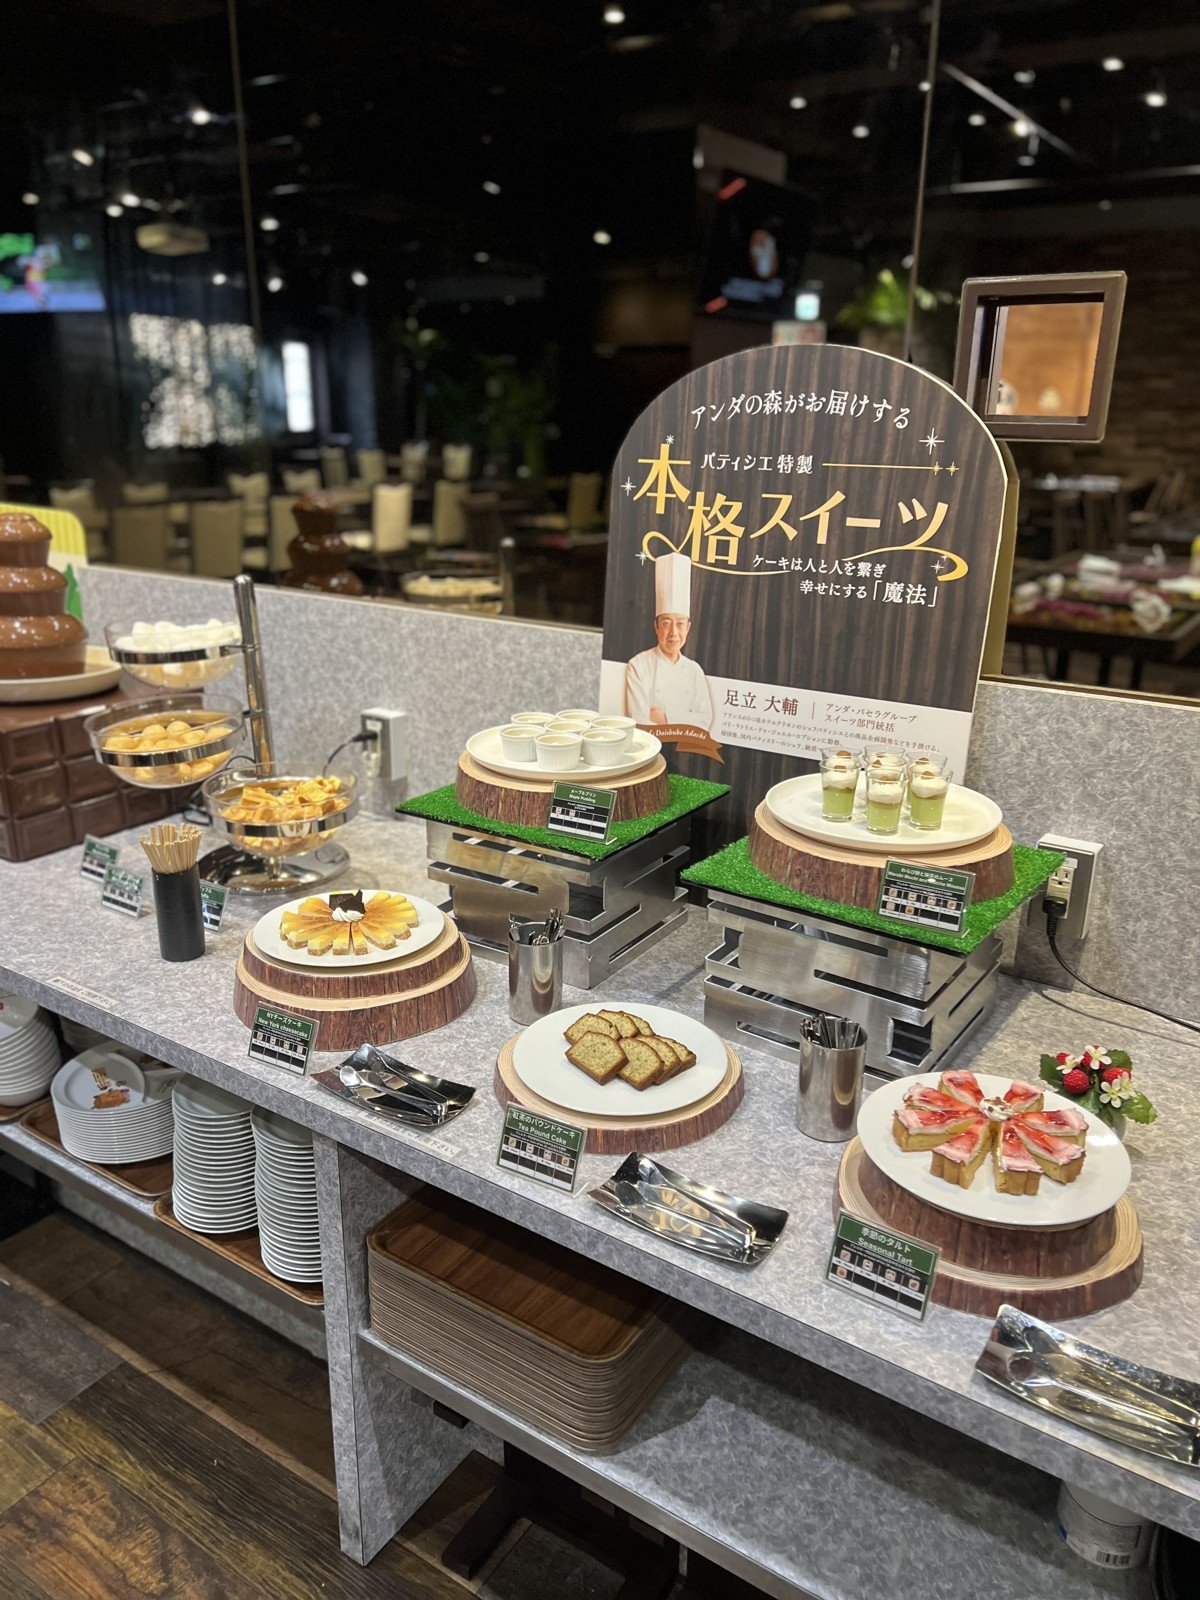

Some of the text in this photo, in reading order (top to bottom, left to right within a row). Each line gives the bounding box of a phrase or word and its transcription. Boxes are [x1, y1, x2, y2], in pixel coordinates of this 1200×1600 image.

[691, 389, 912, 430] アンダの森がお届けする
[700, 452, 814, 475] パティシエ 特製
[632, 443, 949, 566] 本格スイーツ
[752, 554, 887, 578] ケーキは人と人を繋ぎ
[799, 579, 938, 608] 幸せにする「魔法」
[723, 689, 798, 716] 足立 大輔
[684, 729, 707, 740] Adachi
[824, 714, 896, 733] スイーツ部門統括
[258, 1017, 269, 1025] New
[269, 1020, 280, 1029] York
[280, 1024, 308, 1038] cheesecake
[512, 1112, 576, 1139] 紅茶のパウンドケーキ
[518, 1122, 529, 1132] Tea
[529, 1126, 551, 1139] Pound
[551, 1134, 567, 1145] Cake
[857, 1236, 896, 1259] Seasonal
[896, 1252, 913, 1267] Tart
[861, 1226, 911, 1254] 季節のタルト
